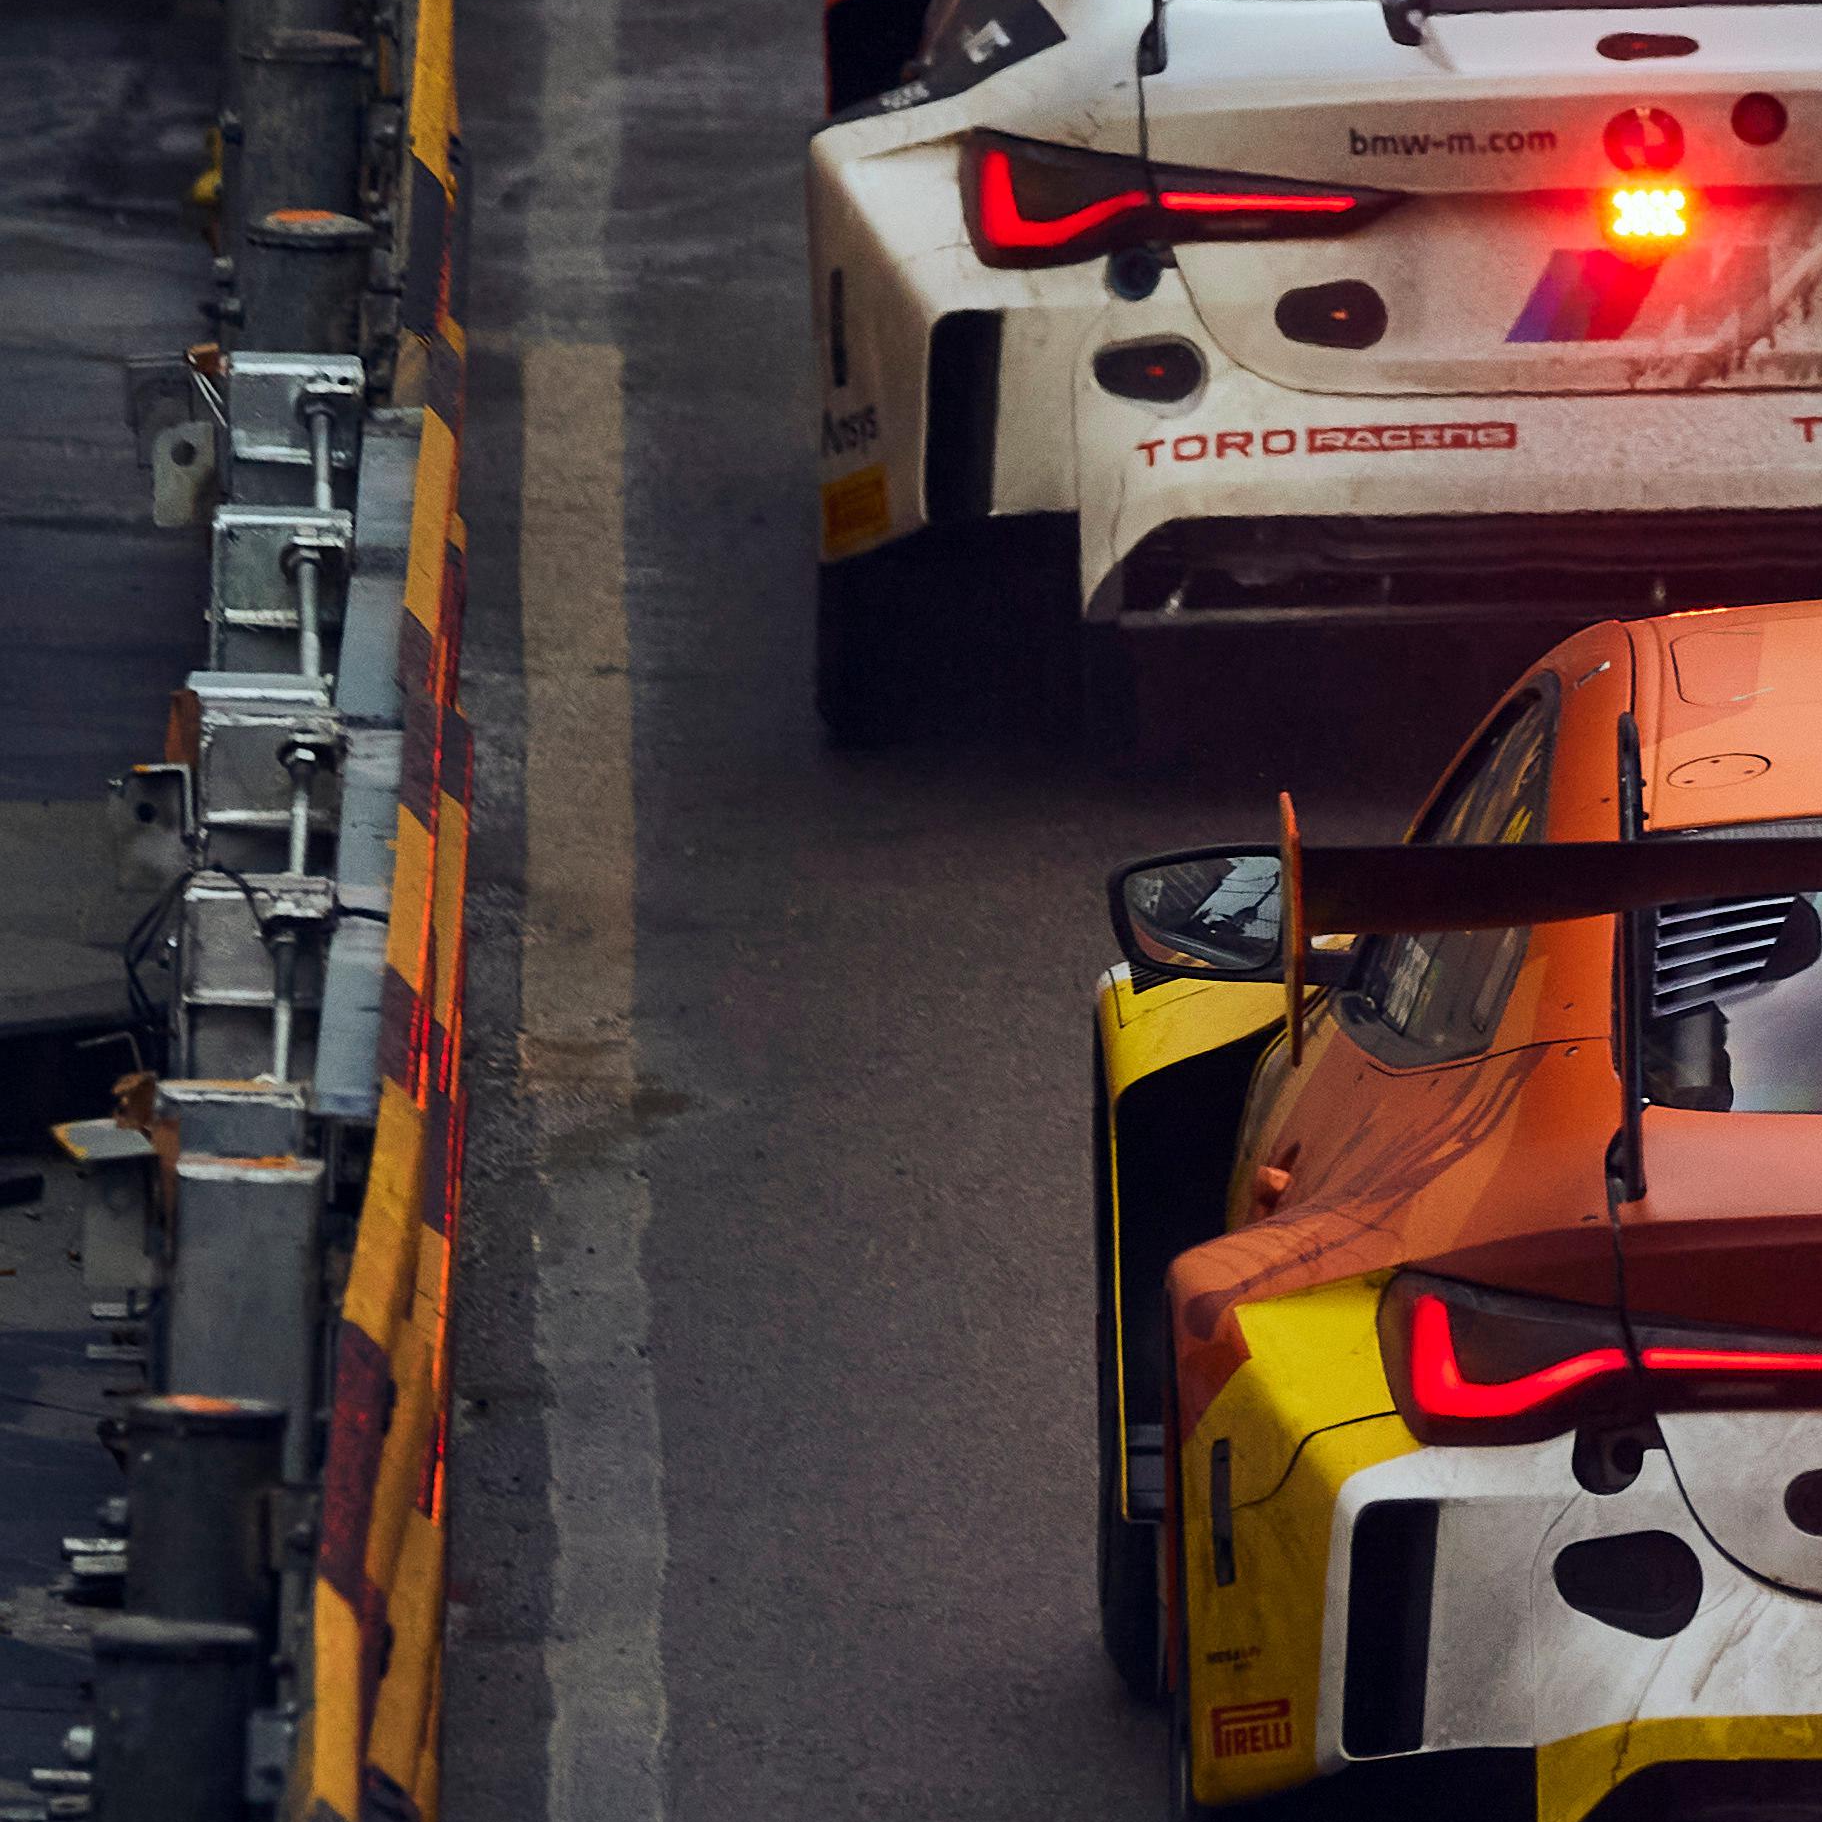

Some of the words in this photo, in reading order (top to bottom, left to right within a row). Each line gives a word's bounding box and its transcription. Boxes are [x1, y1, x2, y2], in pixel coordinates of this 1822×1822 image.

[1350, 127, 1558, 156] bmw-m.com
[1136, 428, 1297, 467] TORO
[1309, 425, 1513, 452] RACING
[1210, 1697, 1292, 1759] PIRELLI
